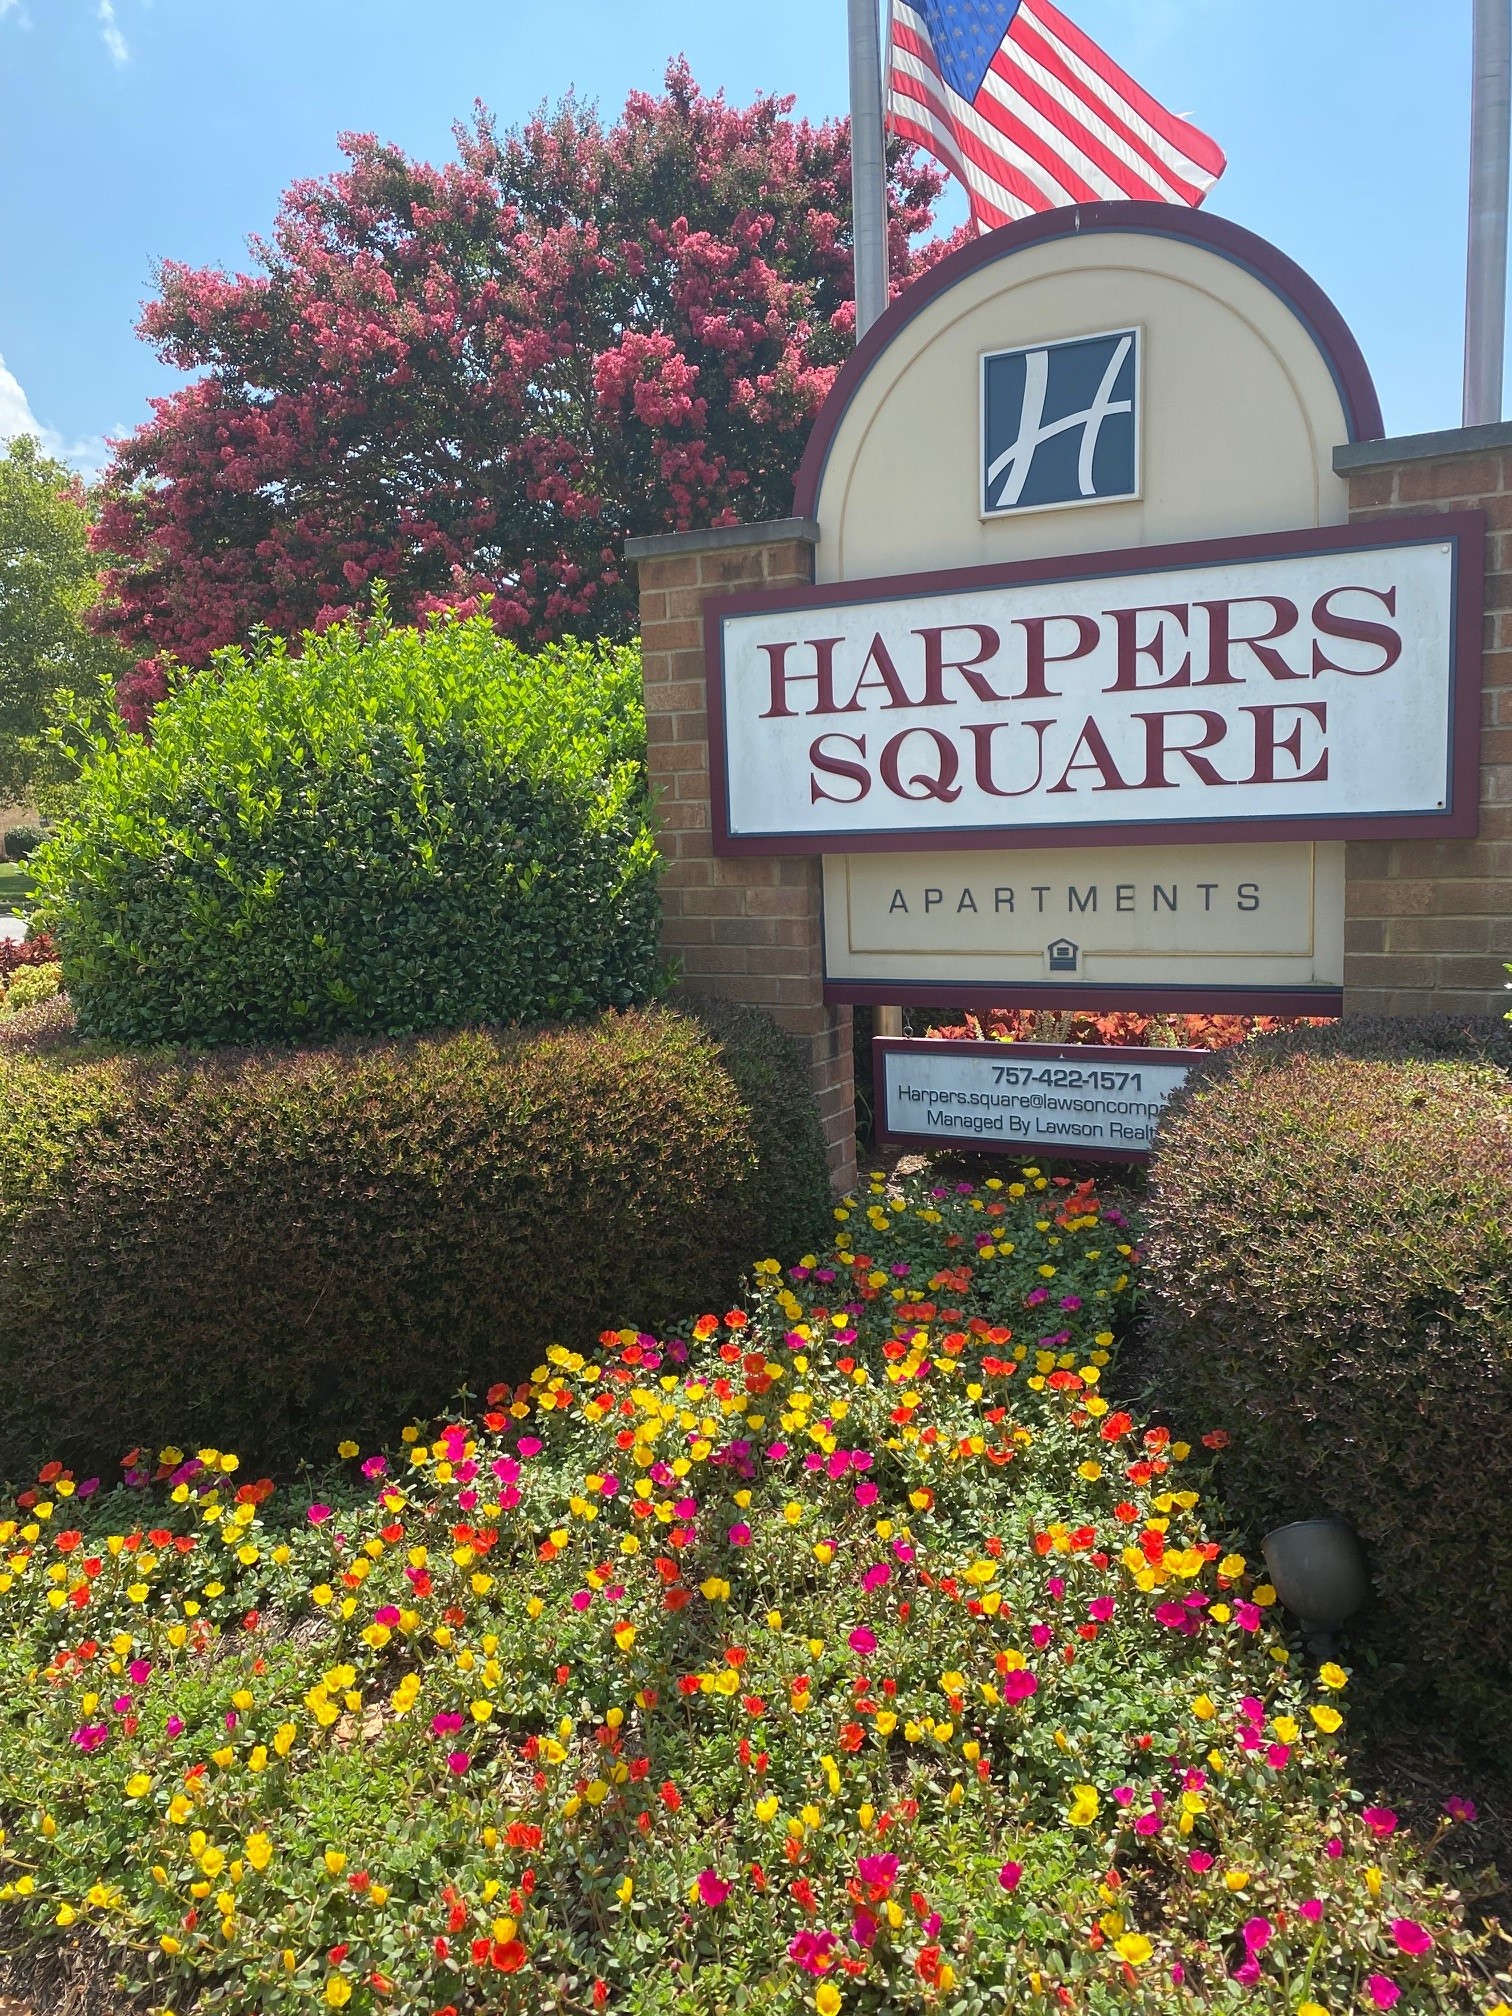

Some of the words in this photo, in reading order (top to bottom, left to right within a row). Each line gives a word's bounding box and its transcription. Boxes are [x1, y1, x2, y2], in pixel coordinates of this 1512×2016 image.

[756, 585, 1402, 719] HARPERS
[809, 701, 1329, 804] SQUARE
[889, 882, 1261, 915] APARTMENTS
[992, 1066, 1142, 1092] 757-422-1571
[927, 1109, 1003, 1132] Managed
[1009, 1115, 1031, 1136] By
[1036, 1118, 1103, 1137] Lawson
